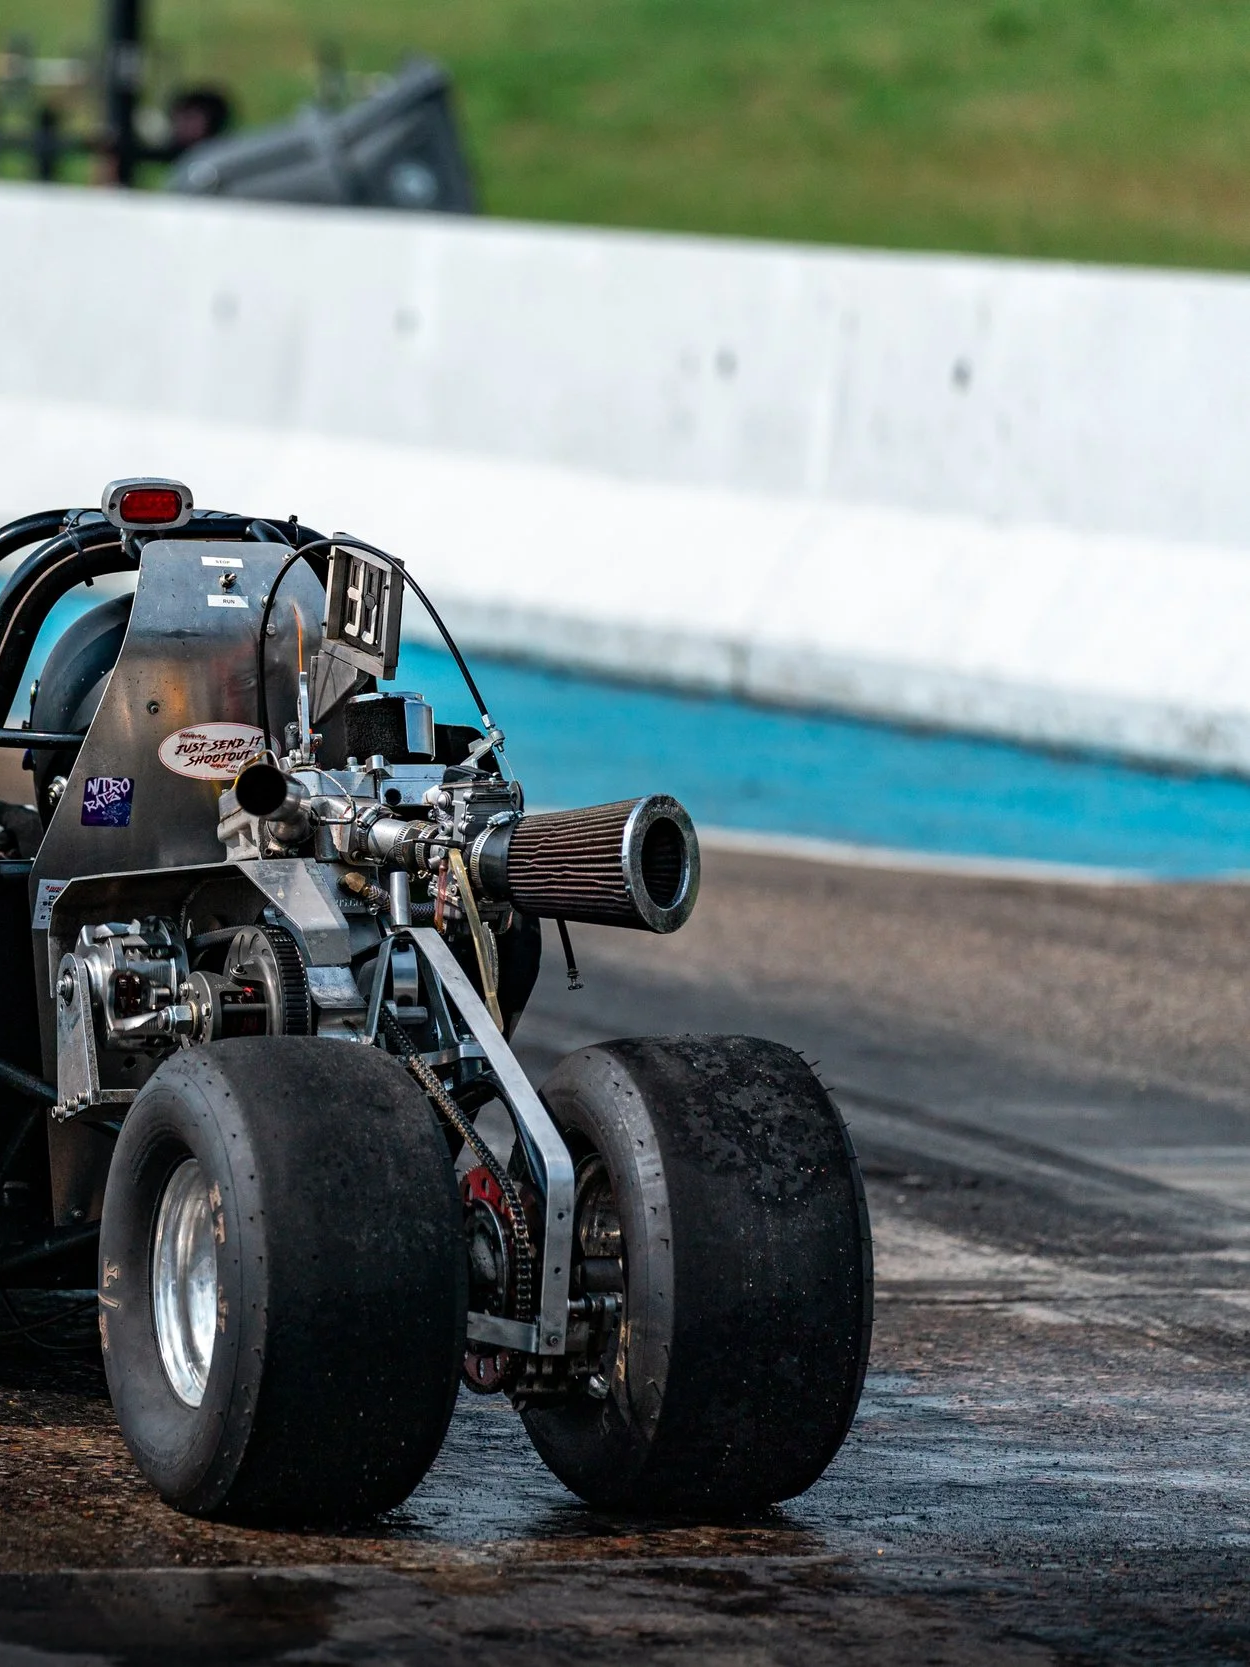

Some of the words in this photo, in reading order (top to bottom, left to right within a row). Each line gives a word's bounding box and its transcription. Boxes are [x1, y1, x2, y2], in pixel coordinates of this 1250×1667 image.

[175, 742, 207, 756] JUST
[208, 737, 246, 752] SEND
[249, 735, 264, 747] IT
[184, 750, 253, 767] SHOOTOUT
[87, 777, 130, 797] NITRO
